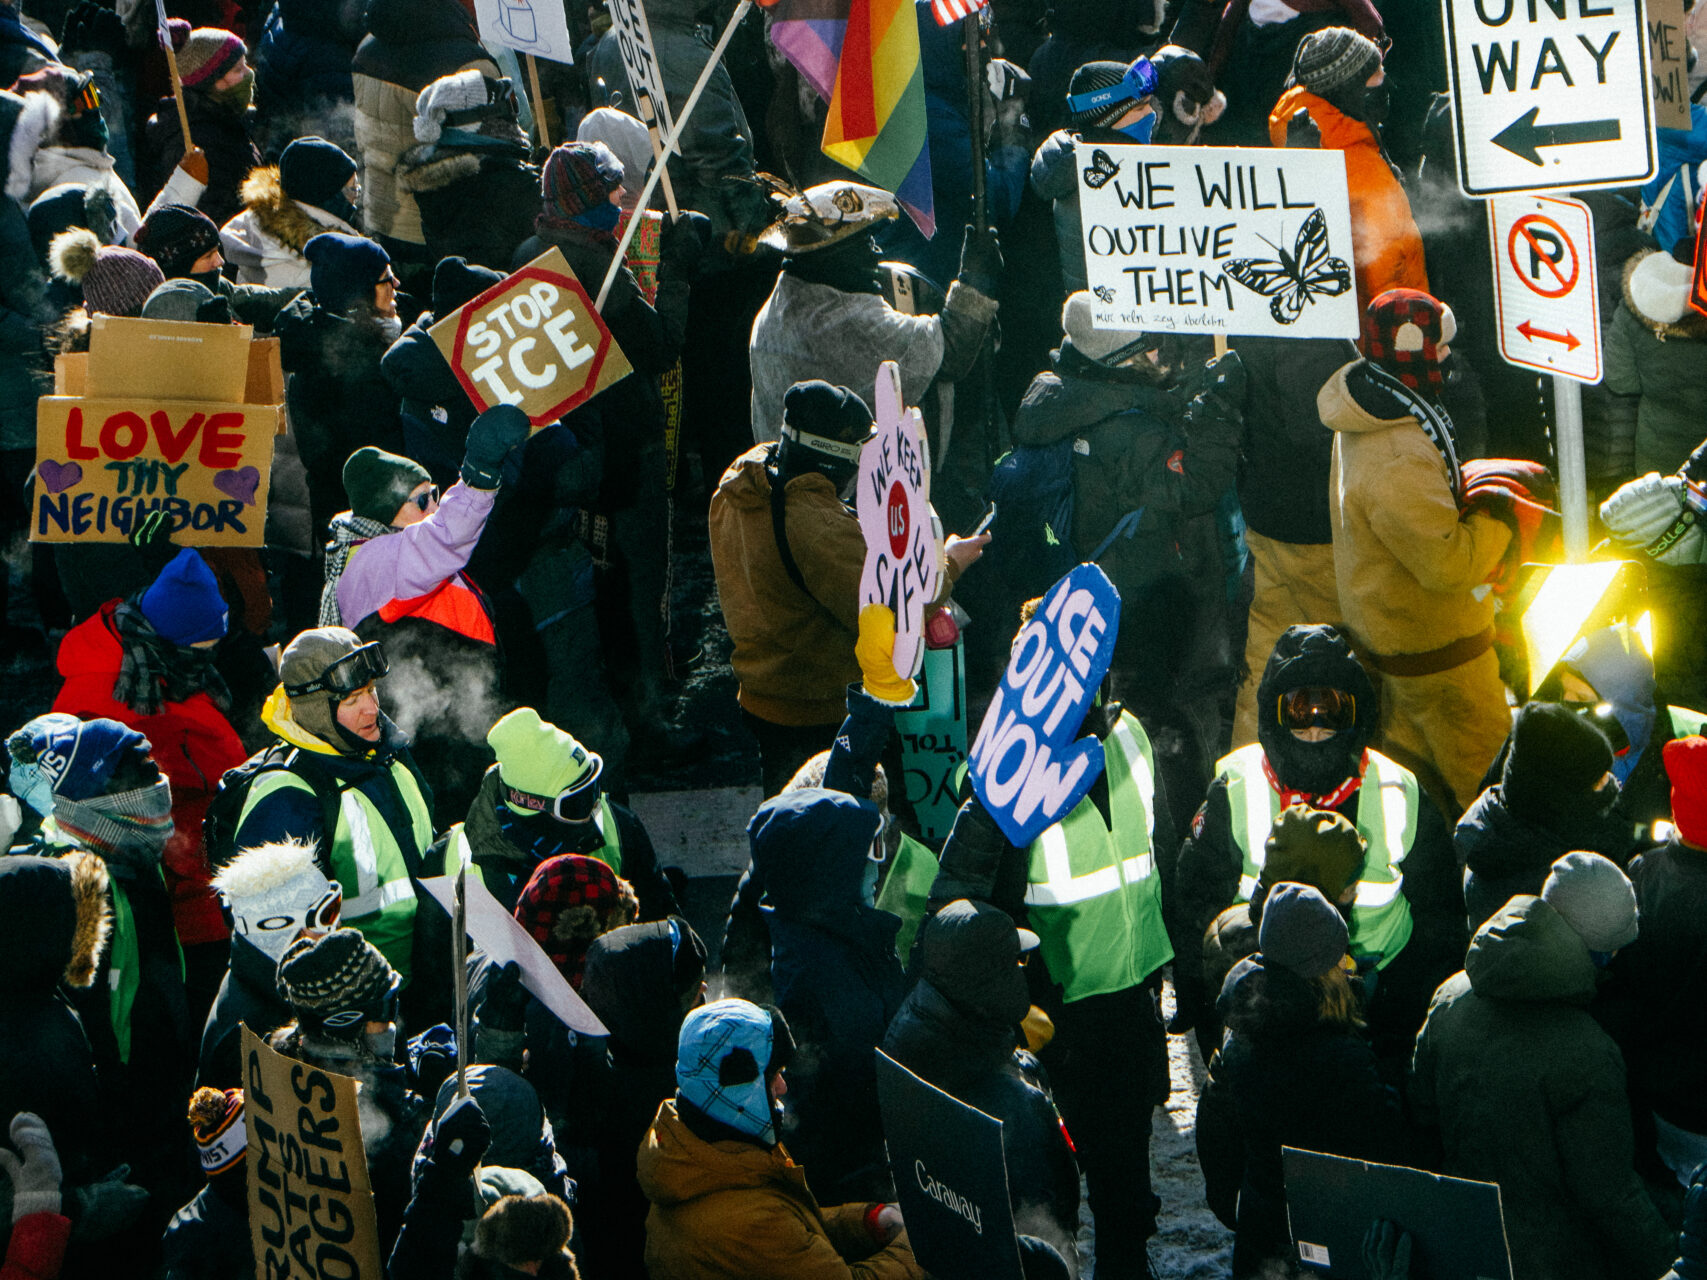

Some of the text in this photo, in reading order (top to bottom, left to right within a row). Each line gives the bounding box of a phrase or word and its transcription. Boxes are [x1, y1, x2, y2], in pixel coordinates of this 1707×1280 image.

[1471, 30, 1622, 95] WAY
[1114, 161, 1316, 210] WE WILL
[1088, 222, 1238, 260] OUTLIVE
[465, 281, 560, 359] STOP
[1122, 266, 1235, 312] THEM
[471, 308, 596, 408] ICE
[65, 406, 248, 469] LOVE
[870, 425, 922, 507] WE KEEP
[39, 491, 249, 536] NEIGHBOR
[105, 461, 190, 497] THY
[1644, 521, 1687, 558] bollé
[868, 525, 930, 634] SAFE
[1045, 577, 1107, 680] ICE
[1007, 620, 1087, 738] OUT
[969, 688, 1090, 827] NOW
[914, 1159, 983, 1235] Caraway
